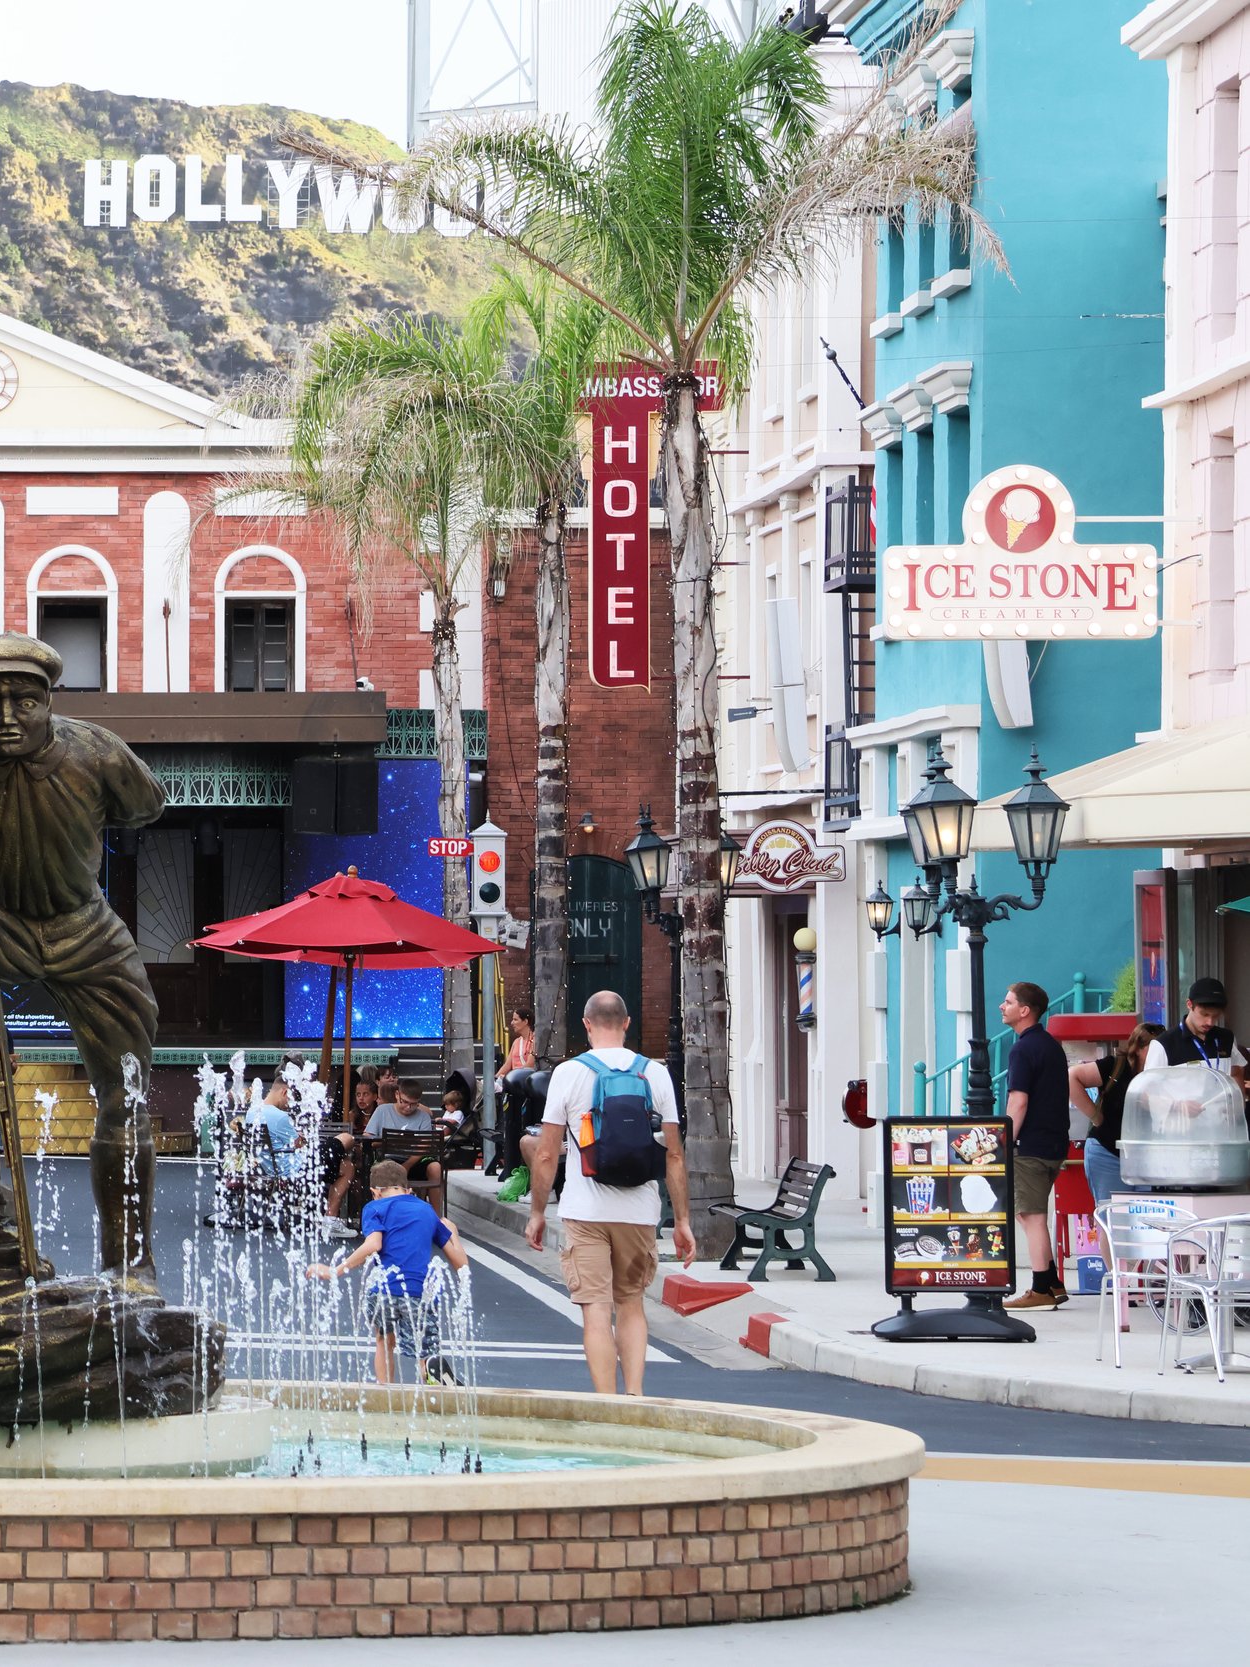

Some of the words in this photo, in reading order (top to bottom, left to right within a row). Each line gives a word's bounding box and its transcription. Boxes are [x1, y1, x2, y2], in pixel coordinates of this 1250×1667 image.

[603, 425, 638, 678] HOTEL
[902, 563, 976, 612] ICE
[988, 563, 1138, 612] STONE
[943, 608, 1082, 619] CREAMERY
[430, 839, 468, 855] STOP
[754, 826, 807, 849] CROISSANDWICH
[783, 848, 840, 877] Club
[568, 901, 619, 912] LIVERIES
[935, 1271, 951, 1283] ICE
[953, 1271, 987, 1283] STONE
